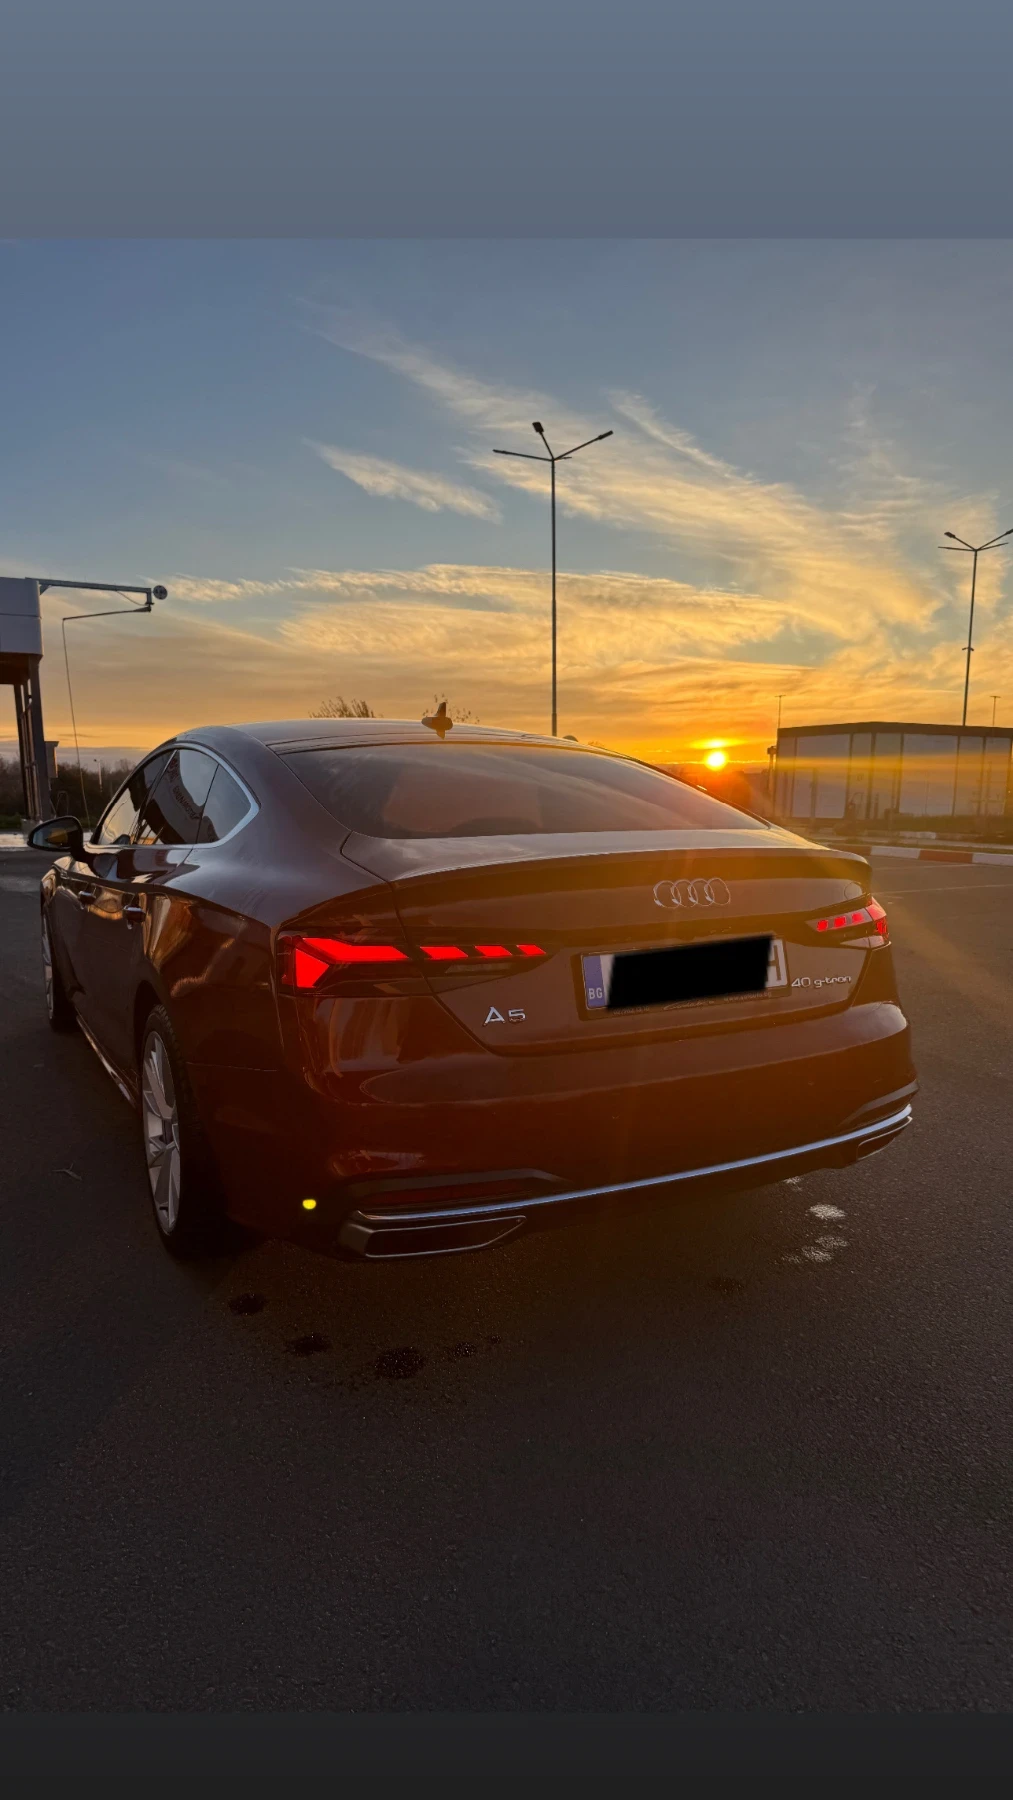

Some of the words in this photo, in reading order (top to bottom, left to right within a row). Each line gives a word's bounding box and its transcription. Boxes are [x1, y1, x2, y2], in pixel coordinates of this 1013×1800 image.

[791, 977, 811, 988] 40
[814, 975, 852, 988] g-tron
[588, 987, 603, 1000] BG
[483, 1006, 526, 1026] A5
